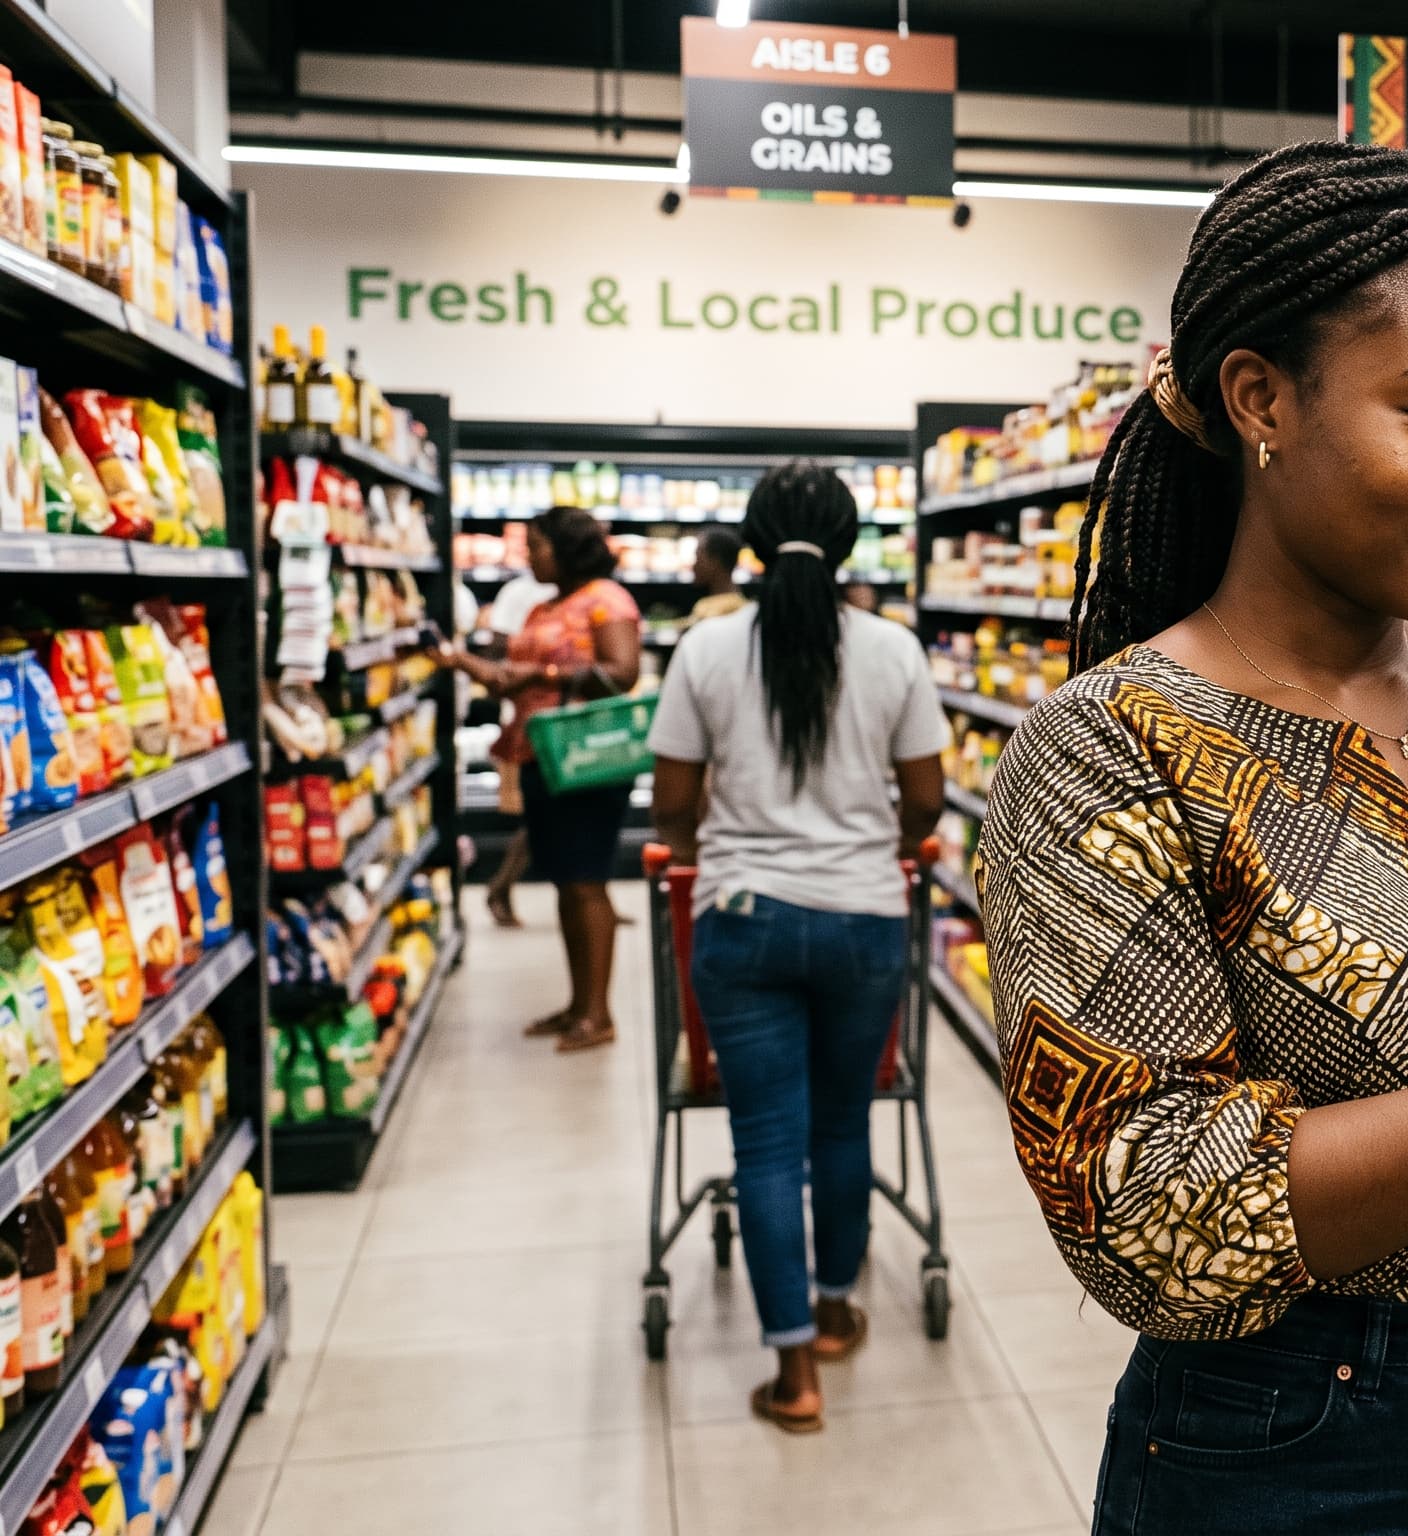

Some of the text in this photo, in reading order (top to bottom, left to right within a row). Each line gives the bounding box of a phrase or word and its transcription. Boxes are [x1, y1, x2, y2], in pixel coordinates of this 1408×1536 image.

[752, 37, 892, 77] AISLE 6
[761, 101, 883, 140] OILS &
[751, 136, 893, 176] GRAINS
[346, 267, 1143, 344] Fresh & Local Produce
